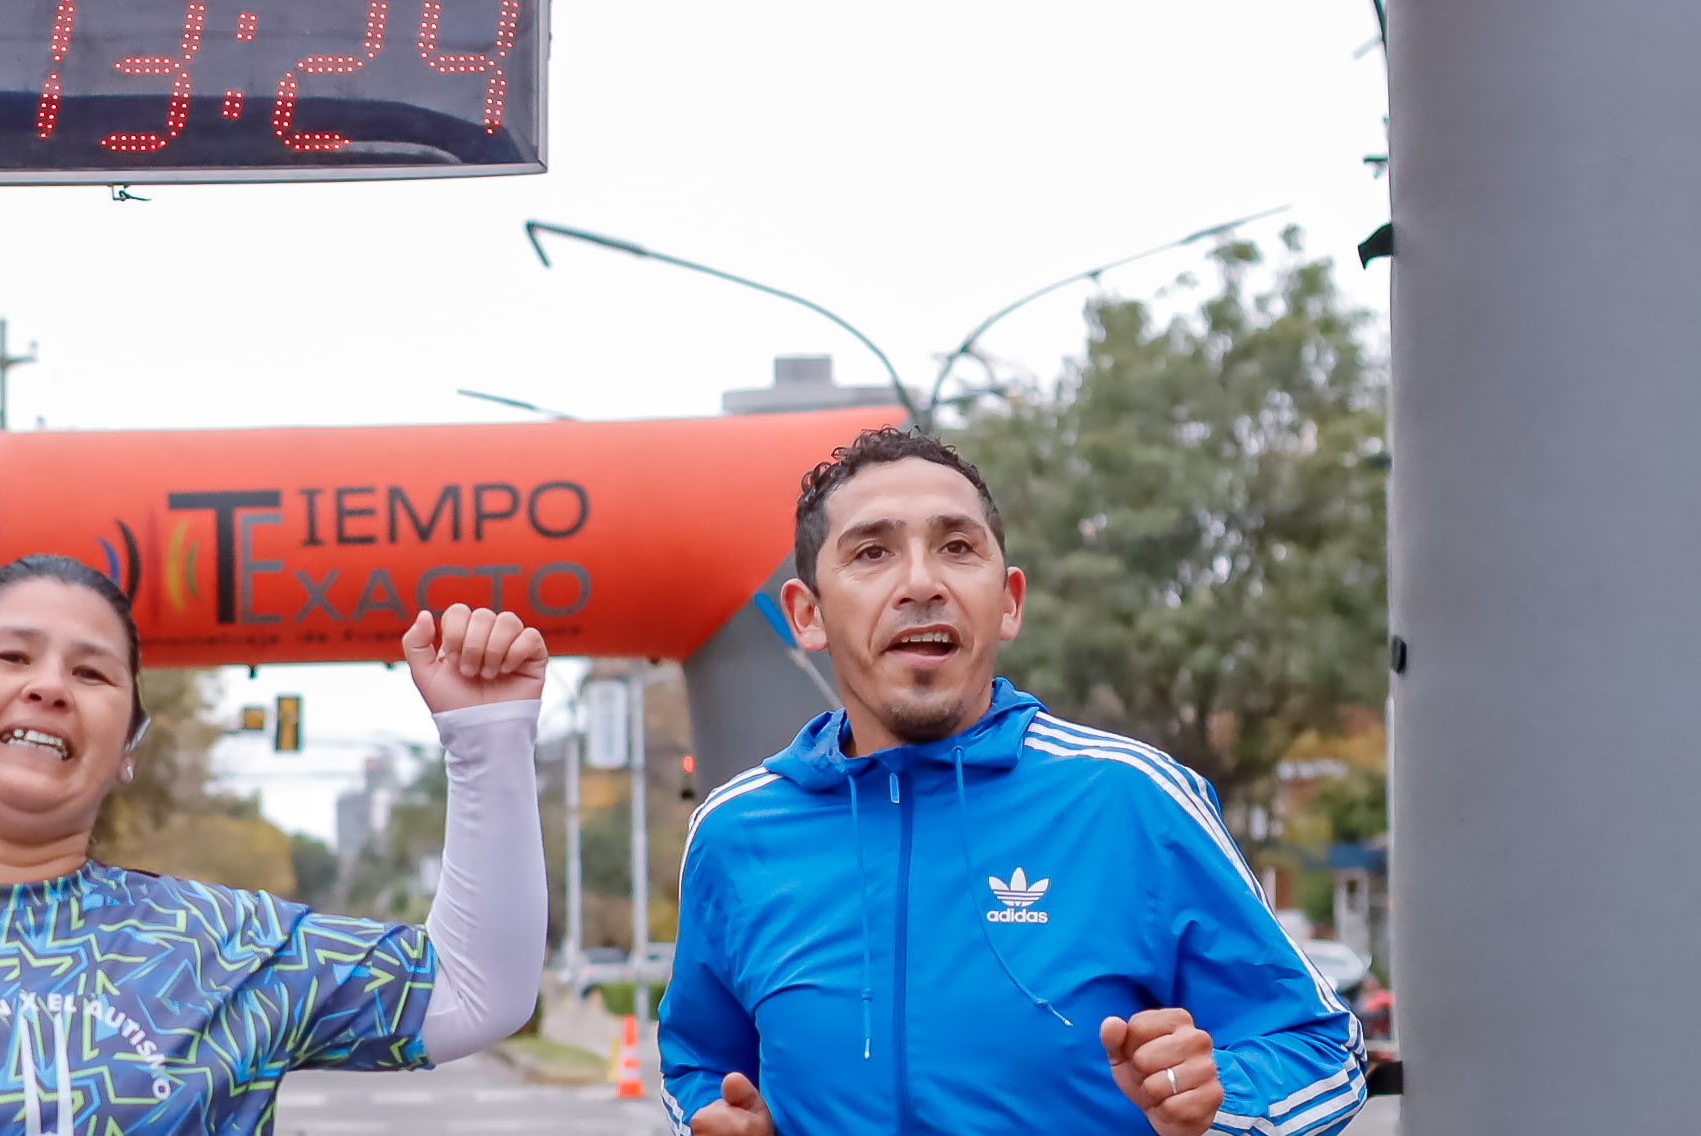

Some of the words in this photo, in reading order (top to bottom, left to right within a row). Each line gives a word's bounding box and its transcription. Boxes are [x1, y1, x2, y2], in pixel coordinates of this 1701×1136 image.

[168, 480, 591, 624] TIEMPO
[238, 513, 592, 624] EXACTO
[986, 907, 1049, 924] adidas
[19, 992, 39, 1012] X
[47, 993, 77, 1013] EL
[85, 1000, 171, 1100] AUTISMO
